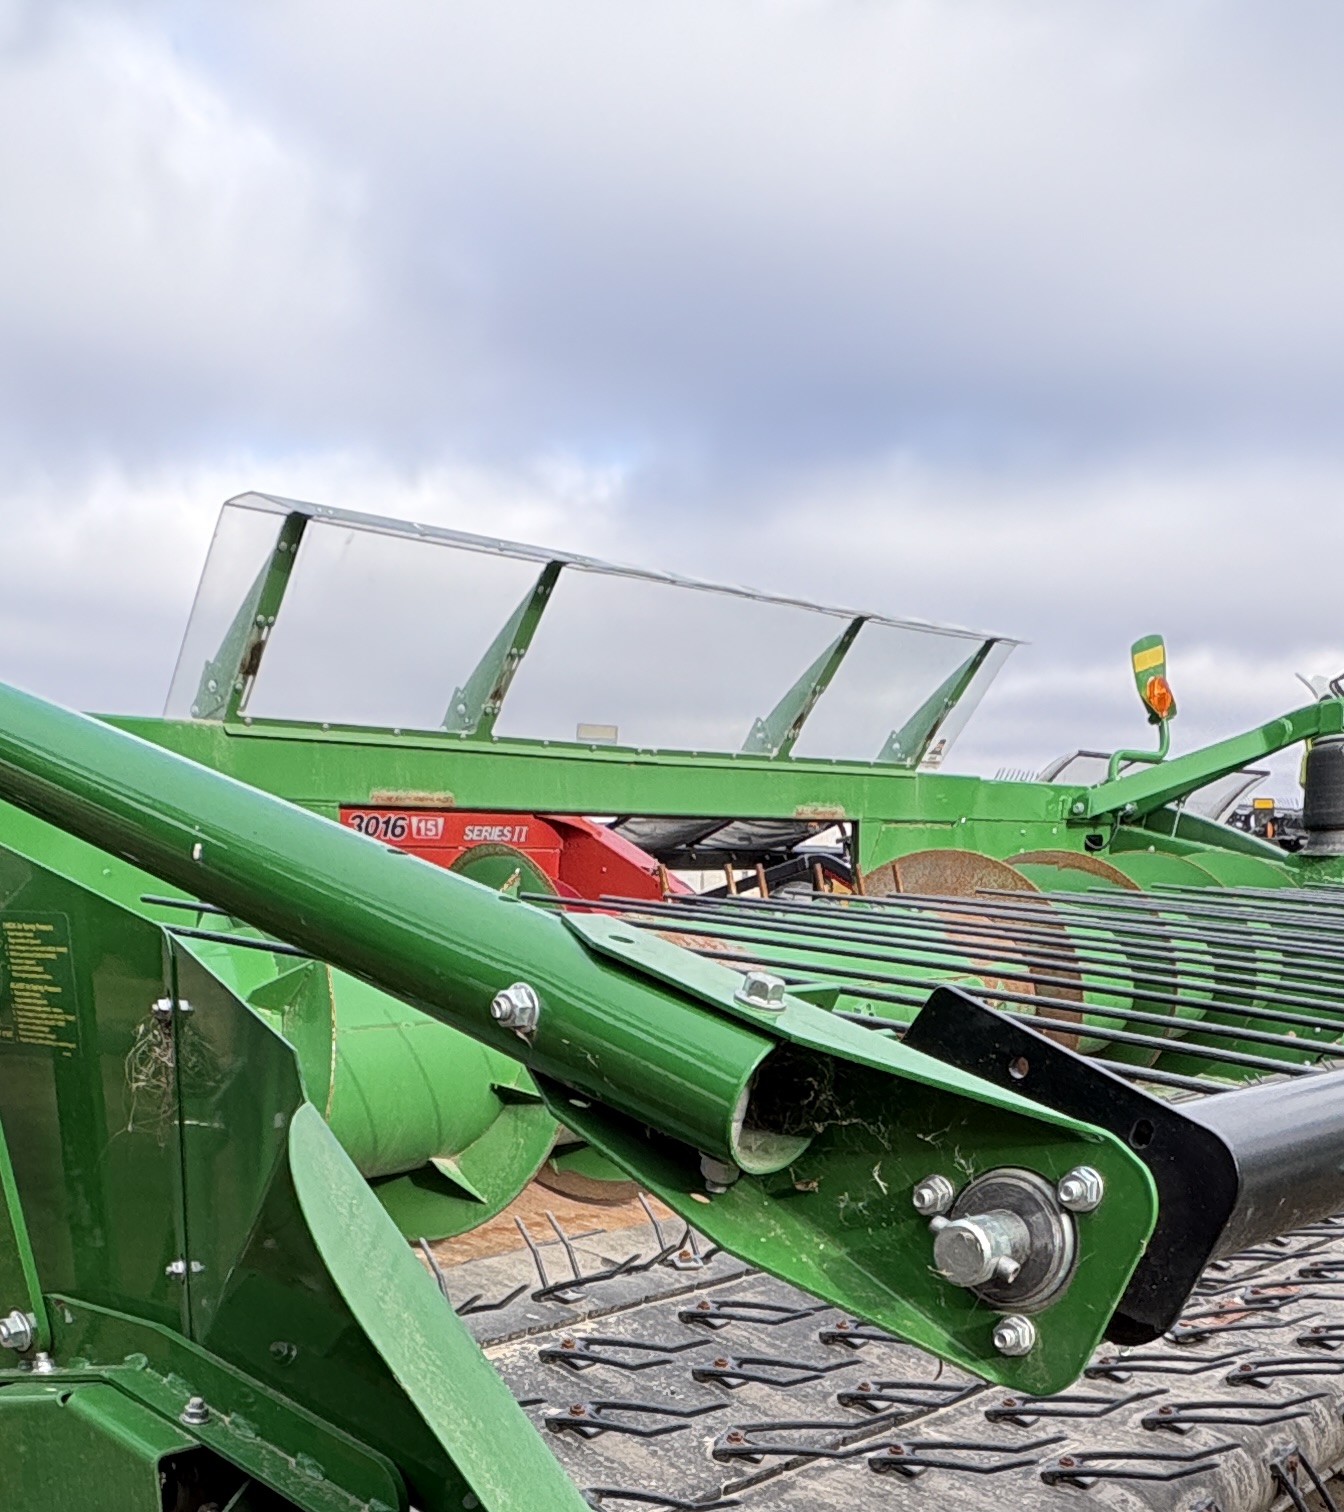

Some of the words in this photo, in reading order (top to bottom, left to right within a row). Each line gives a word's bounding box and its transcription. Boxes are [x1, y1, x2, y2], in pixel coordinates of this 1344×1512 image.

[349, 813, 409, 841] 3016
[418, 819, 437, 837] 15
[463, 825, 513, 842] SERIES
